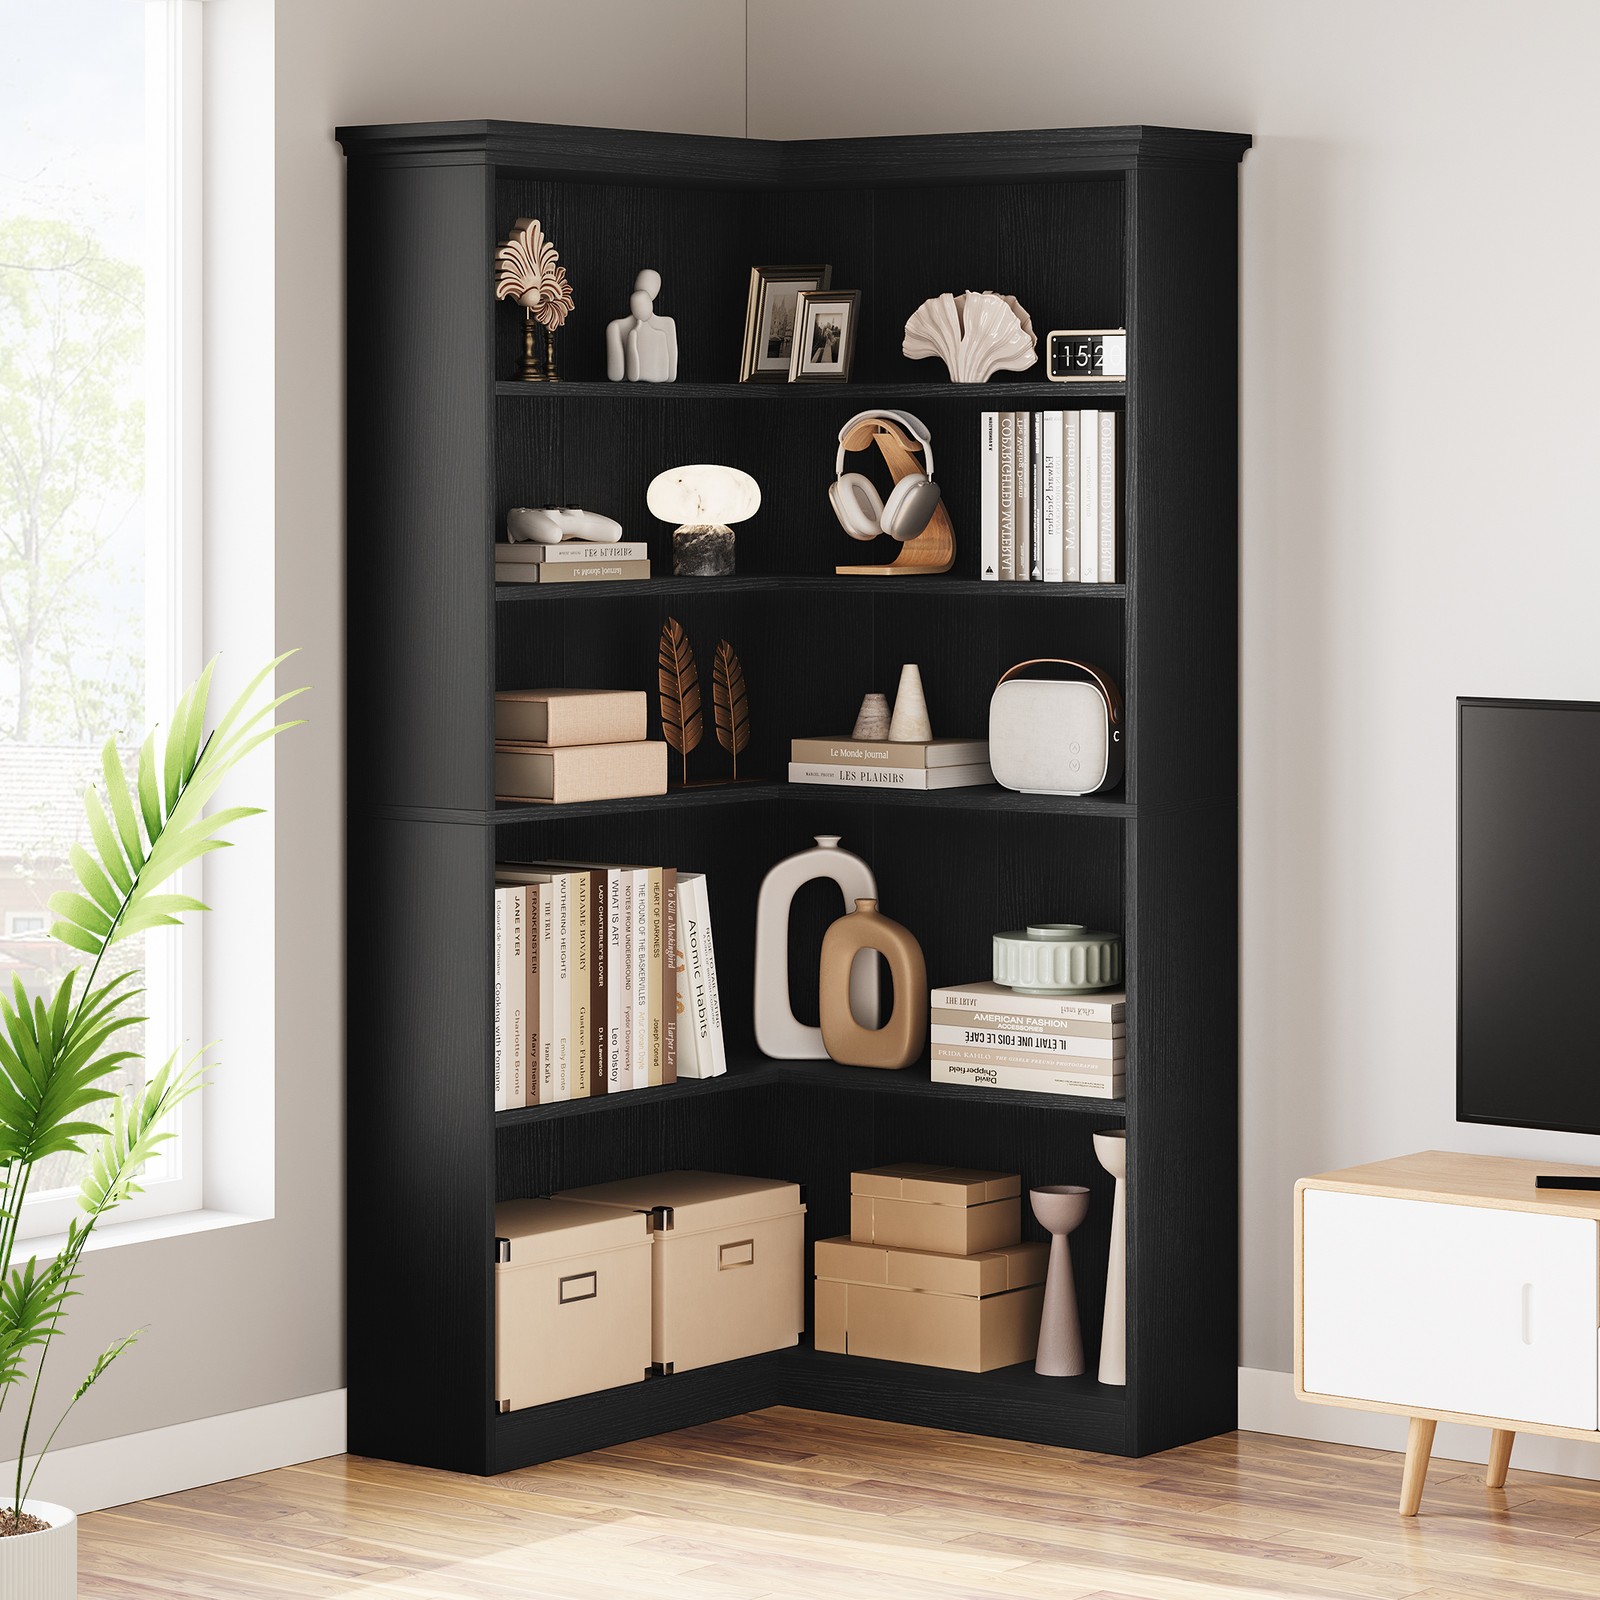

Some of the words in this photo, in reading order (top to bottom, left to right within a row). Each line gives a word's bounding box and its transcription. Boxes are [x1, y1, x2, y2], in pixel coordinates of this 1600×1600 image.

[831, 748, 839, 757] Le
[840, 749, 862, 758] Monde
[864, 750, 888, 760] Journal
[839, 771, 856, 781] LES
[860, 771, 904, 783] PLAISIRS
[668, 887, 675, 897] To
[654, 908, 660, 917] OF
[612, 914, 619, 923] IS
[639, 927, 645, 935] OF
[497, 933, 501, 941] de
[665, 923, 675, 968] Mockingbird
[709, 957, 714, 968] TO
[689, 920, 701, 979] Atomic
[696, 985, 708, 1038] Habits
[974, 1013, 1023, 1024] AMERICAN
[1026, 1017, 1067, 1028] FASHION
[997, 1024, 1043, 1032] ACCESSORIES
[665, 1022, 675, 1049] Harper
[965, 1031, 984, 1043] CAFÉ
[987, 1033, 995, 1044] LE
[998, 1034, 1015, 1045] FOIS
[1018, 1036, 1034, 1047] UNE
[1036, 1038, 1057, 1051] ÉTAIT
[1060, 1040, 1066, 1050] IL
[938, 1049, 962, 1057] FRIDA
[964, 1052, 991, 1060] KAHLO
[610, 1049, 619, 1082] Tolstoy
[637, 1052, 645, 1070] Doyle
[949, 1066, 997, 1077] Chipperfield
[975, 1076, 997, 1084] David
